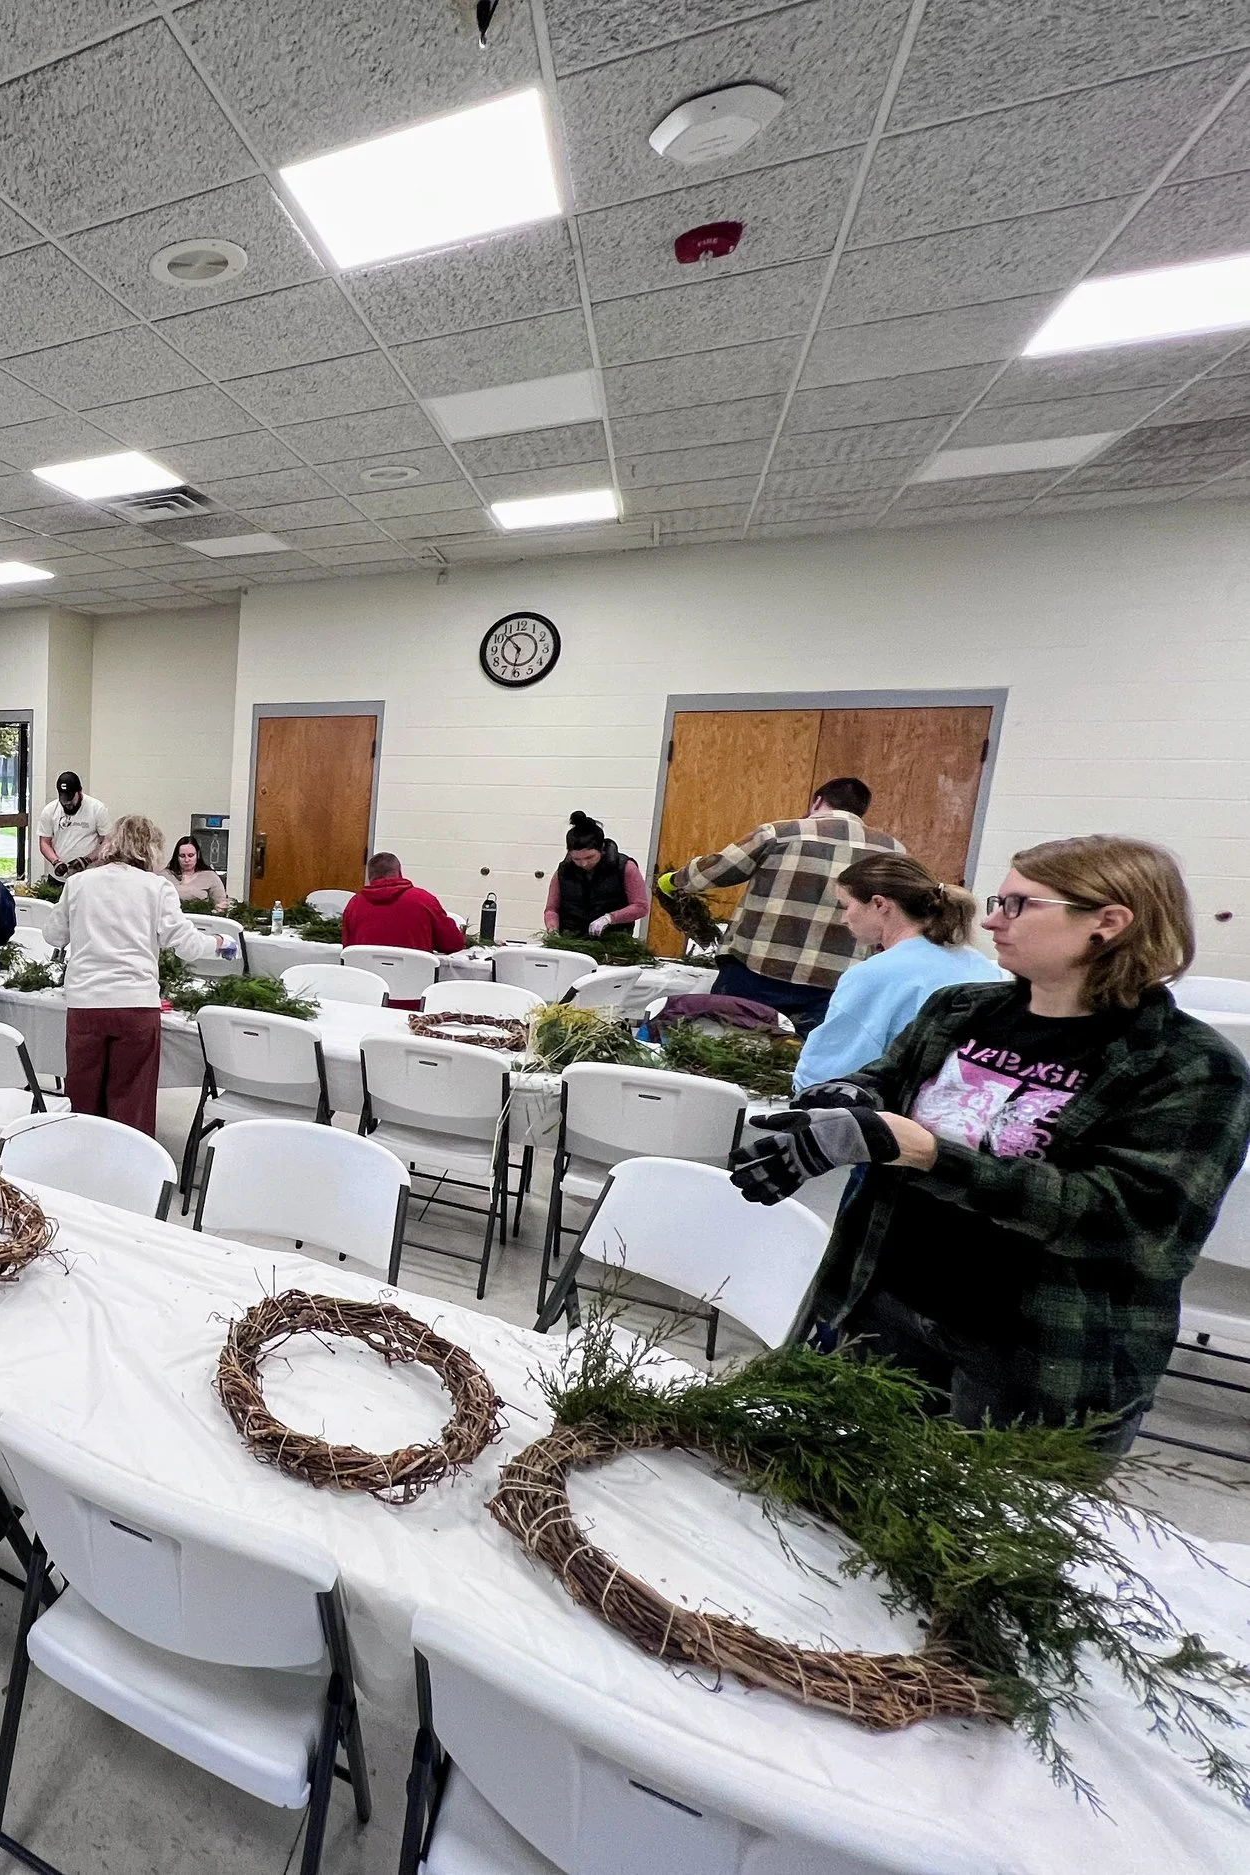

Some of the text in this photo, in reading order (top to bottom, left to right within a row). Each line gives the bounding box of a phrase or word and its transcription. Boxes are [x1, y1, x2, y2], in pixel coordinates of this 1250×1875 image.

[697, 237, 718, 247] FIRE
[504, 623, 513, 634] 11
[516, 620, 528, 631] 12
[494, 633, 505, 644] 10
[539, 631, 546, 642] 2
[491, 645, 498, 656] 9
[542, 643, 550, 654] 3
[492, 656, 500, 667] 8
[536, 656, 543, 666] 4
[501, 665, 508, 676] 7
[513, 668, 520, 678] 6
[526, 665, 534, 675] 5
[958, 1038, 1088, 1091] ARBAGE
